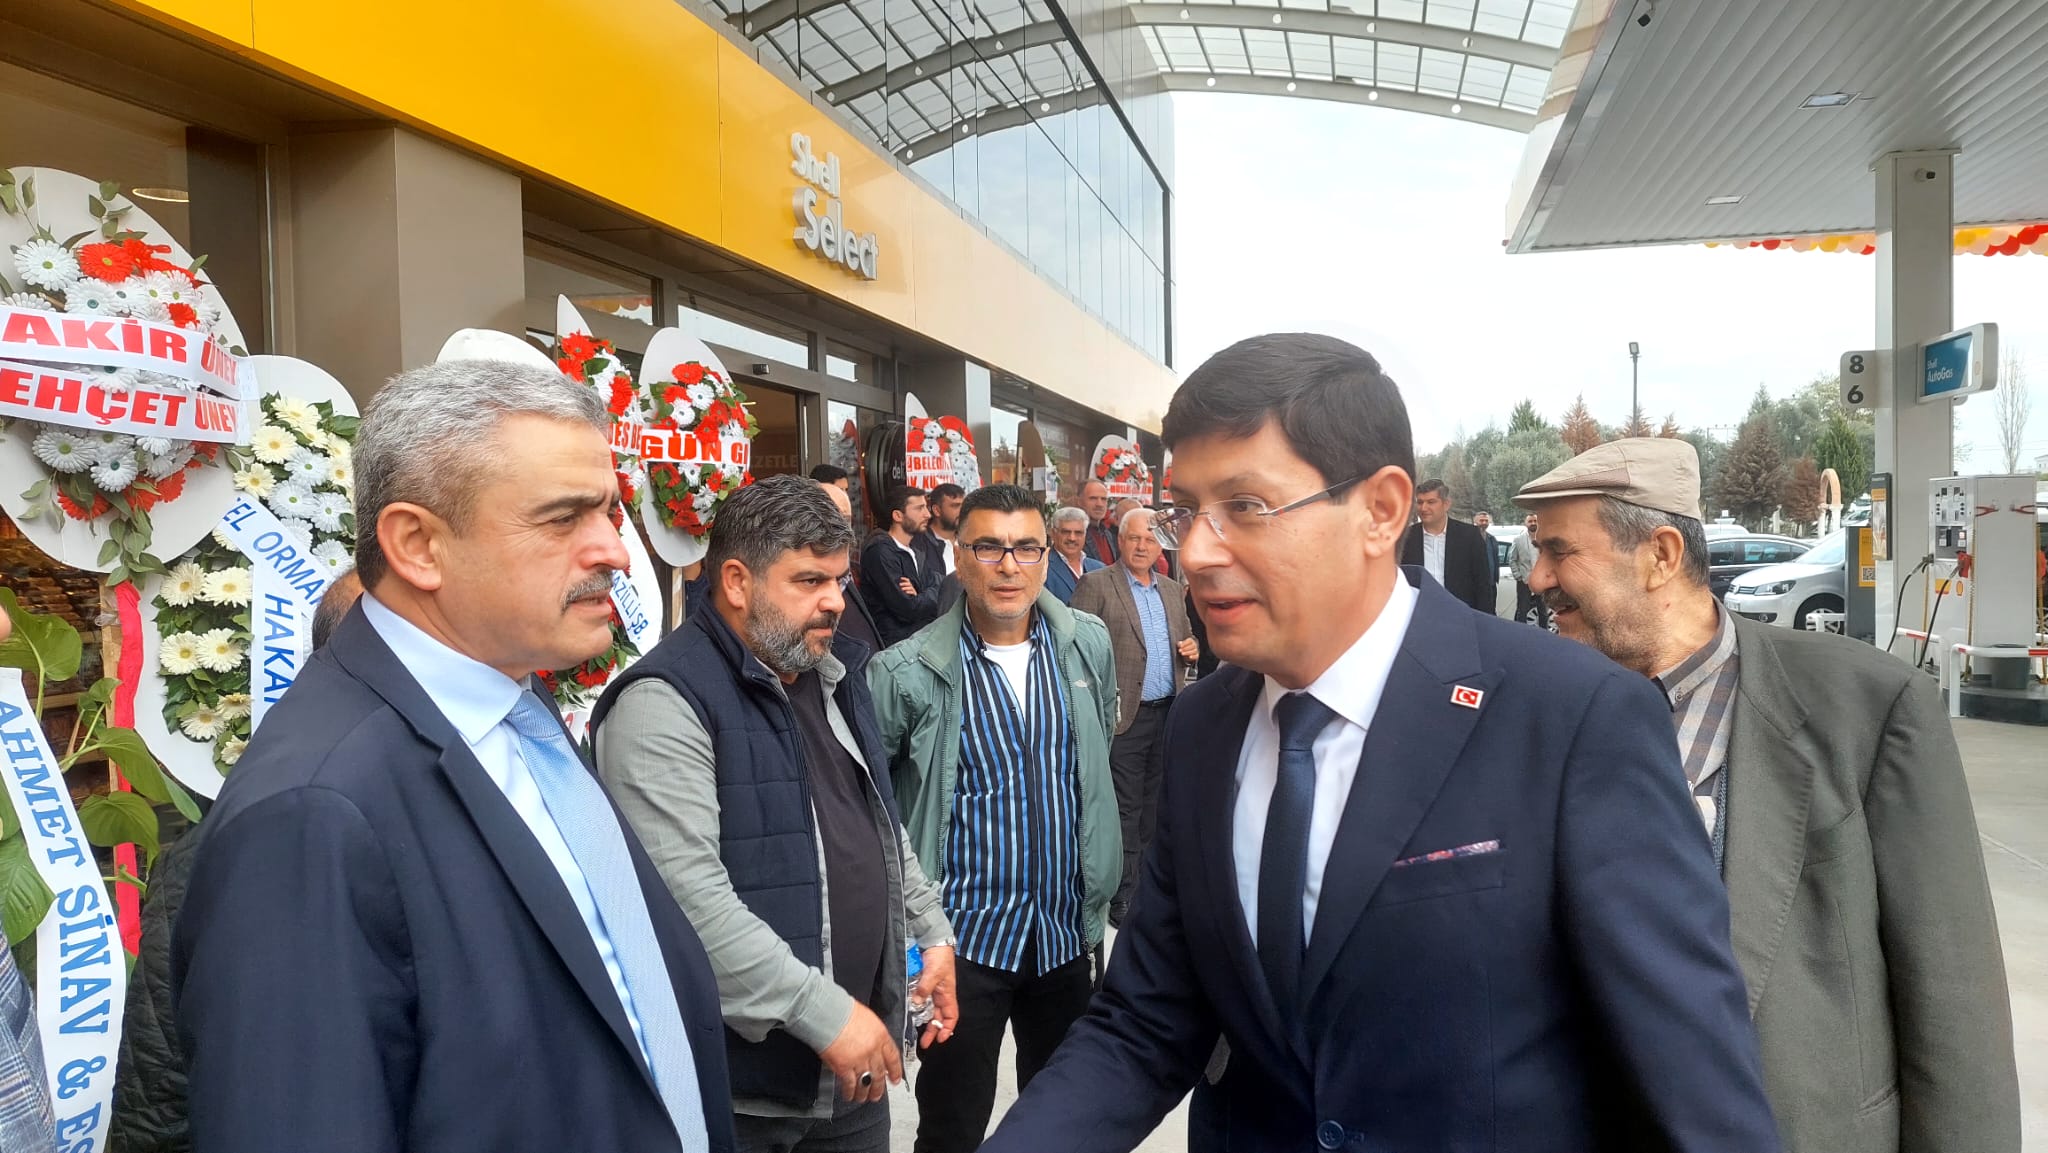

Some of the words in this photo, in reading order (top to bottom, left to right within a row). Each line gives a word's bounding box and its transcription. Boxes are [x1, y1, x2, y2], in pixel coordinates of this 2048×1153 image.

[791, 132, 841, 198] Shell
[792, 187, 880, 281] Select
[1847, 384, 1864, 404] 6
[1849, 354, 1865, 374] 8
[222, 496, 258, 533] EL
[252, 531, 327, 606] ORMA
[613, 571, 641, 619] AZİLLİ
[263, 592, 296, 703] HAKA
[0, 702, 87, 868] AHMET
[56, 884, 115, 1035] SİNAV
[56, 1055, 108, 1100] &
